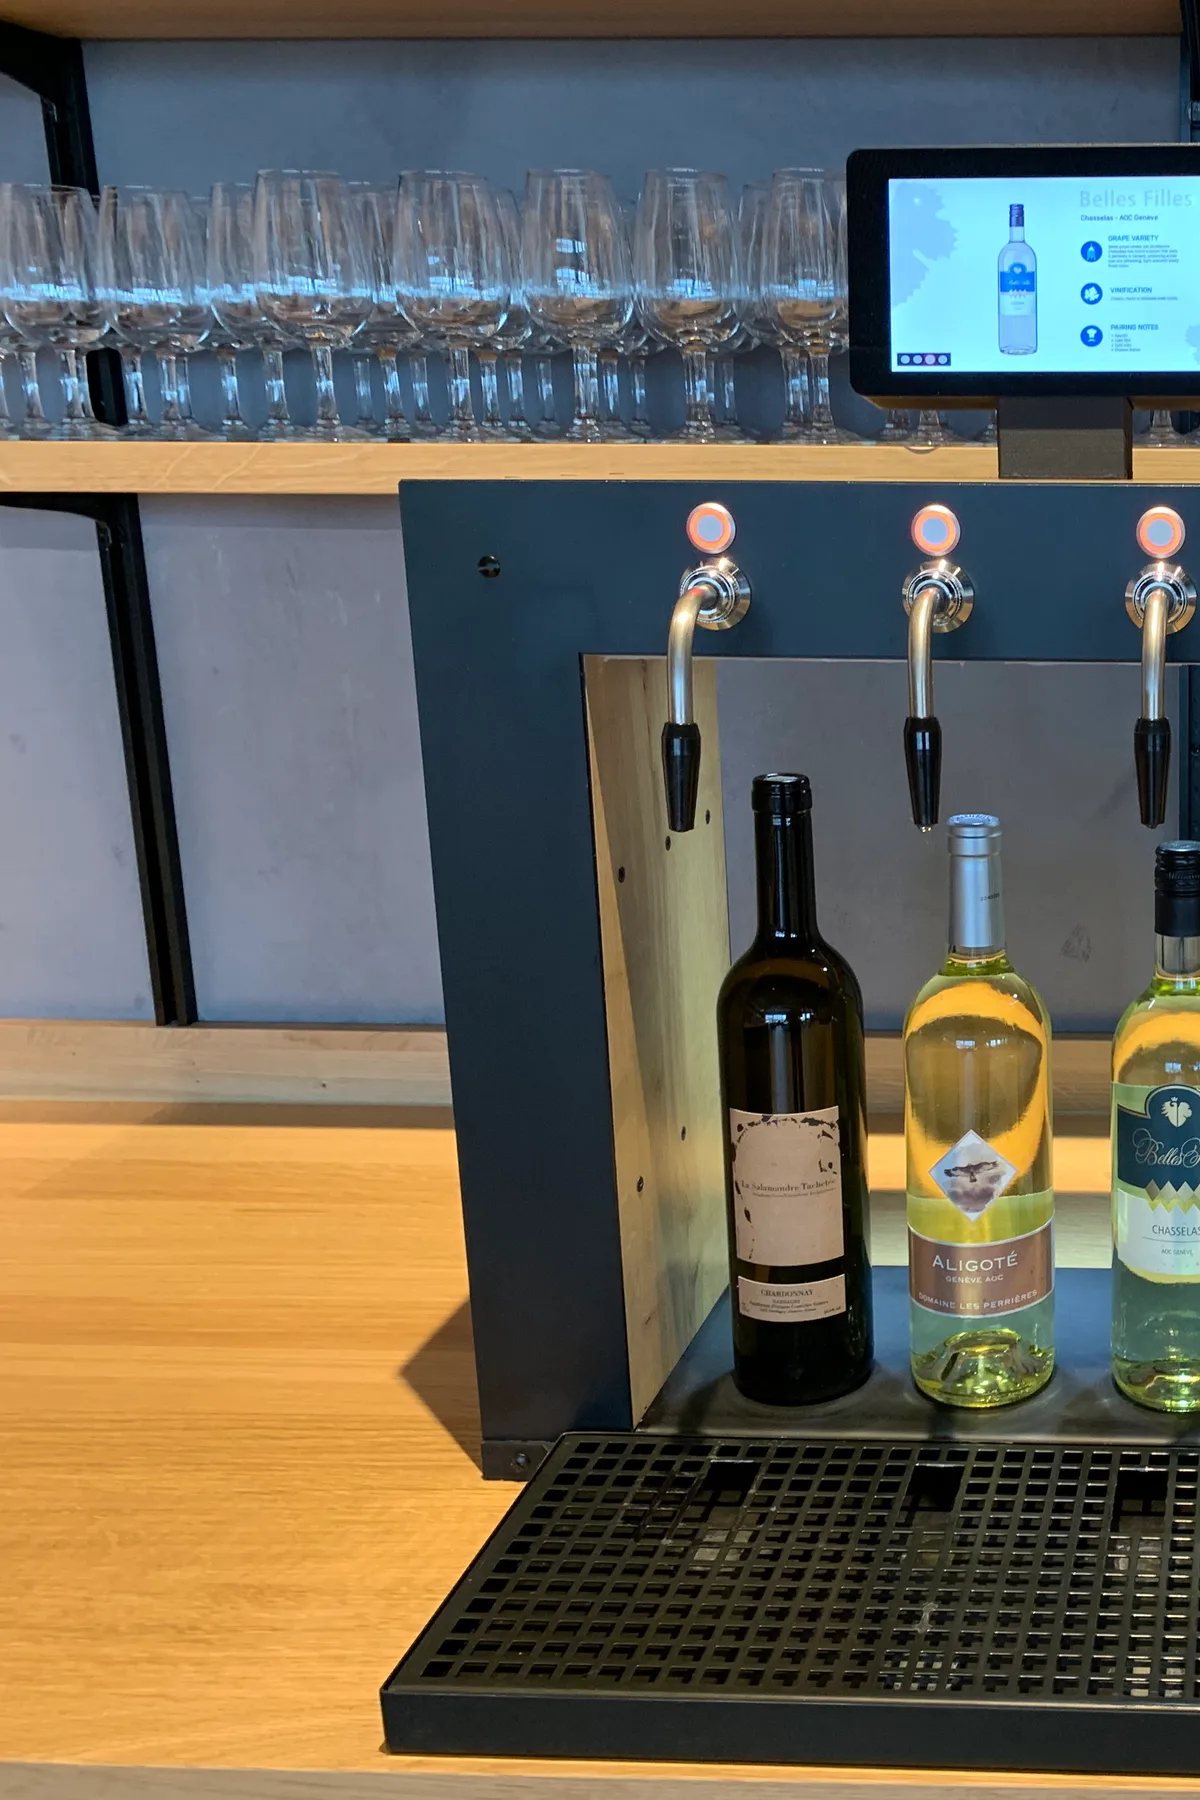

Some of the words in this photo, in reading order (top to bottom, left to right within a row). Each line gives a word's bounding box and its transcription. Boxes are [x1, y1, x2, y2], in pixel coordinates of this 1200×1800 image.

[1080, 189, 1136, 208] Belles
[1144, 188, 1193, 207] Filles
[1132, 1128, 1184, 1166] Belles
[751, 1182, 799, 1192] Salamandre
[932, 1250, 1018, 1272] ALIGOTÉ
[946, 1275, 982, 1284] GENÈVE
[985, 1274, 1004, 1283] AOC
[760, 1289, 814, 1298] CHARDONNAY
[918, 1292, 956, 1309] DOMAINE
[960, 1302, 980, 1310] LES
[983, 1289, 1038, 1309] PERRIÈRES
